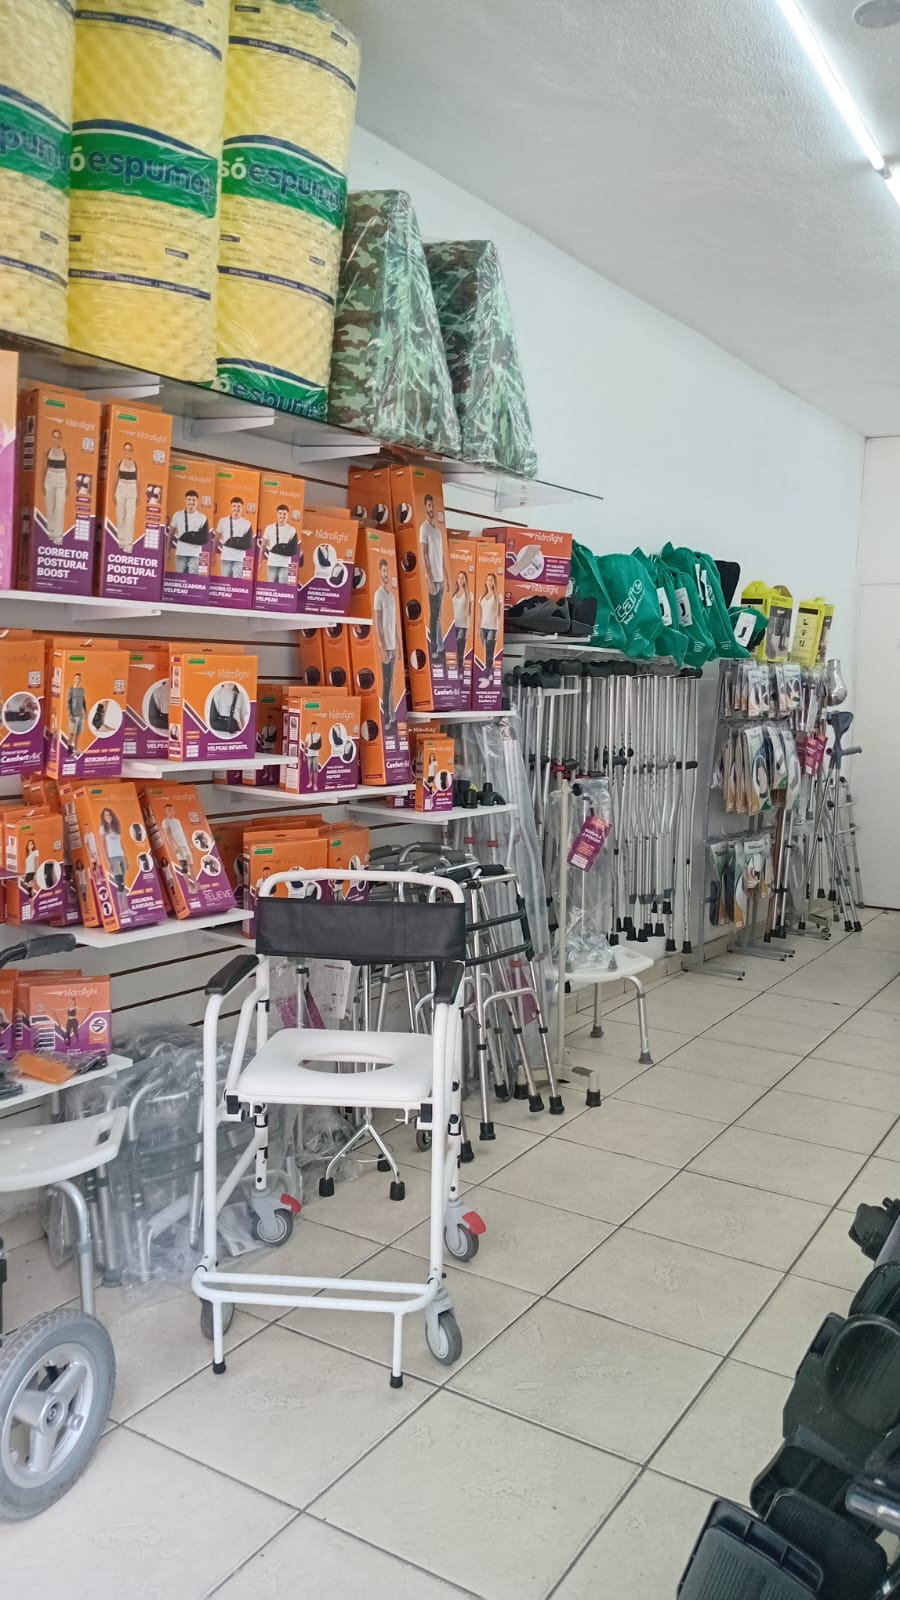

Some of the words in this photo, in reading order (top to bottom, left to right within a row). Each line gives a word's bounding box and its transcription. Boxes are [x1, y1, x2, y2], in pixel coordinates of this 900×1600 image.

[534, 531, 563, 544] hidrolight
[37, 546, 89, 560] CORRETOR
[37, 557, 88, 570] POSTURAL
[107, 554, 158, 568] CORRETOR
[36, 567, 70, 578] BOOST
[106, 564, 157, 577] POSTURAL
[106, 574, 139, 585] BOOST
[64, 987, 98, 998] hidrolight
